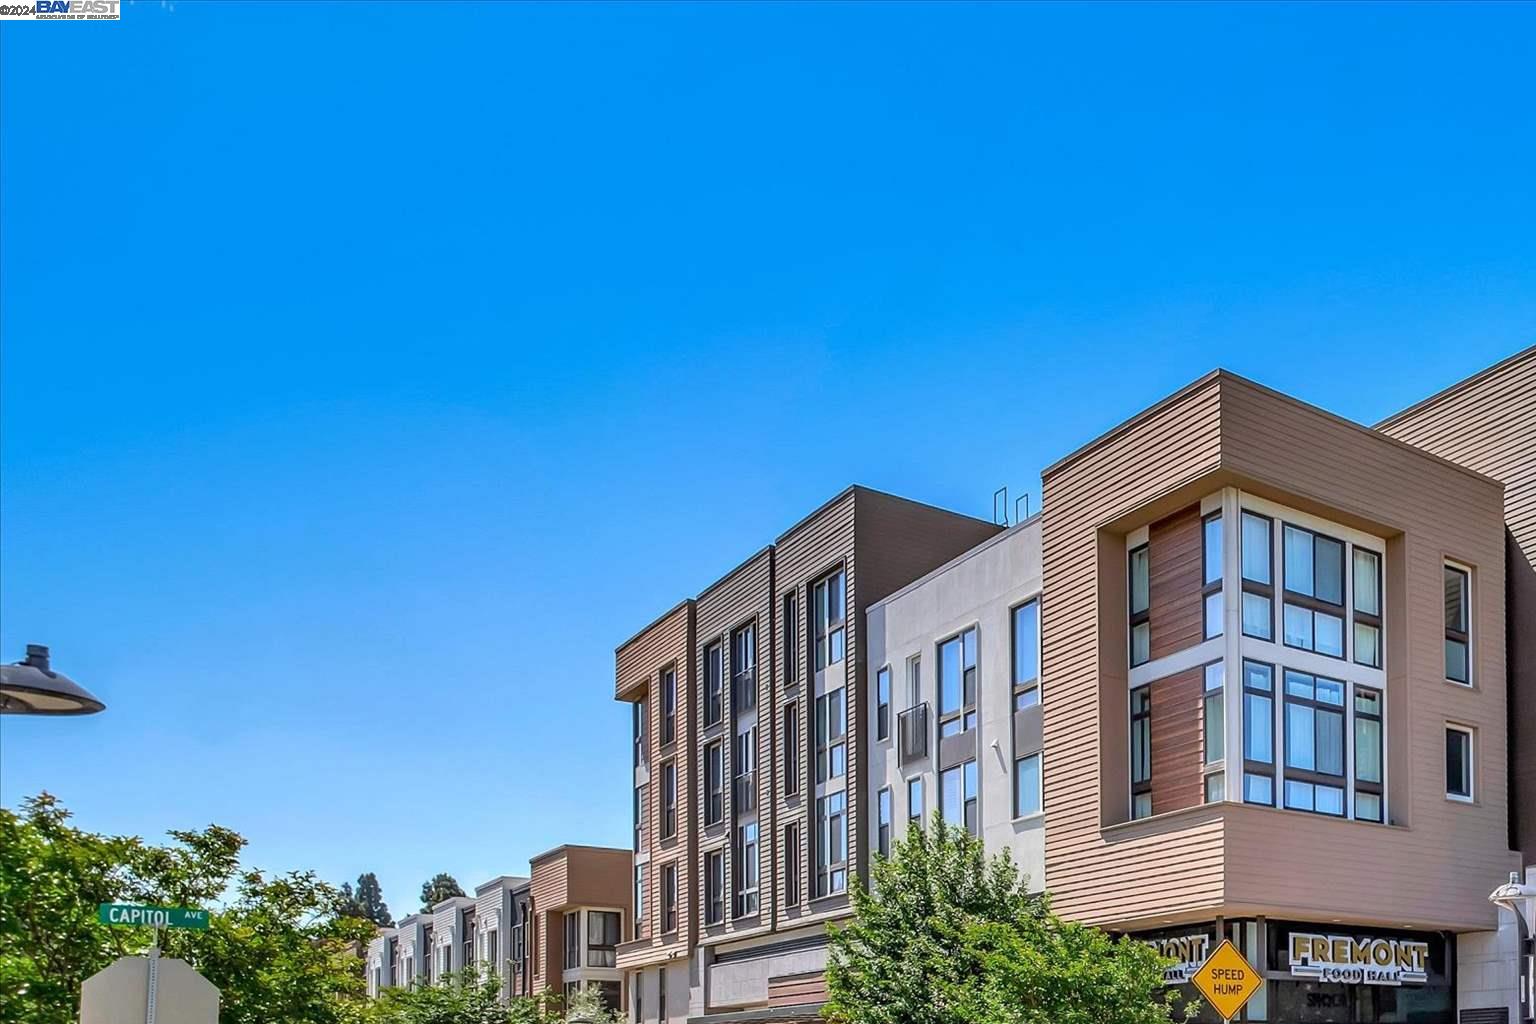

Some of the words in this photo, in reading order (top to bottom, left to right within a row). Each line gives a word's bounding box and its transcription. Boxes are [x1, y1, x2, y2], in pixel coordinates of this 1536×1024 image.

[109, 908, 173, 926] CAPITOL
[184, 911, 203, 920] AVE
[1292, 936, 1428, 968] FREMONT
[1163, 968, 1185, 980] ALL
[1211, 968, 1244, 981] SPEED
[1322, 968, 1361, 980] FOOD
[1367, 970, 1400, 982] HALL
[1213, 983, 1243, 995] HUMP
